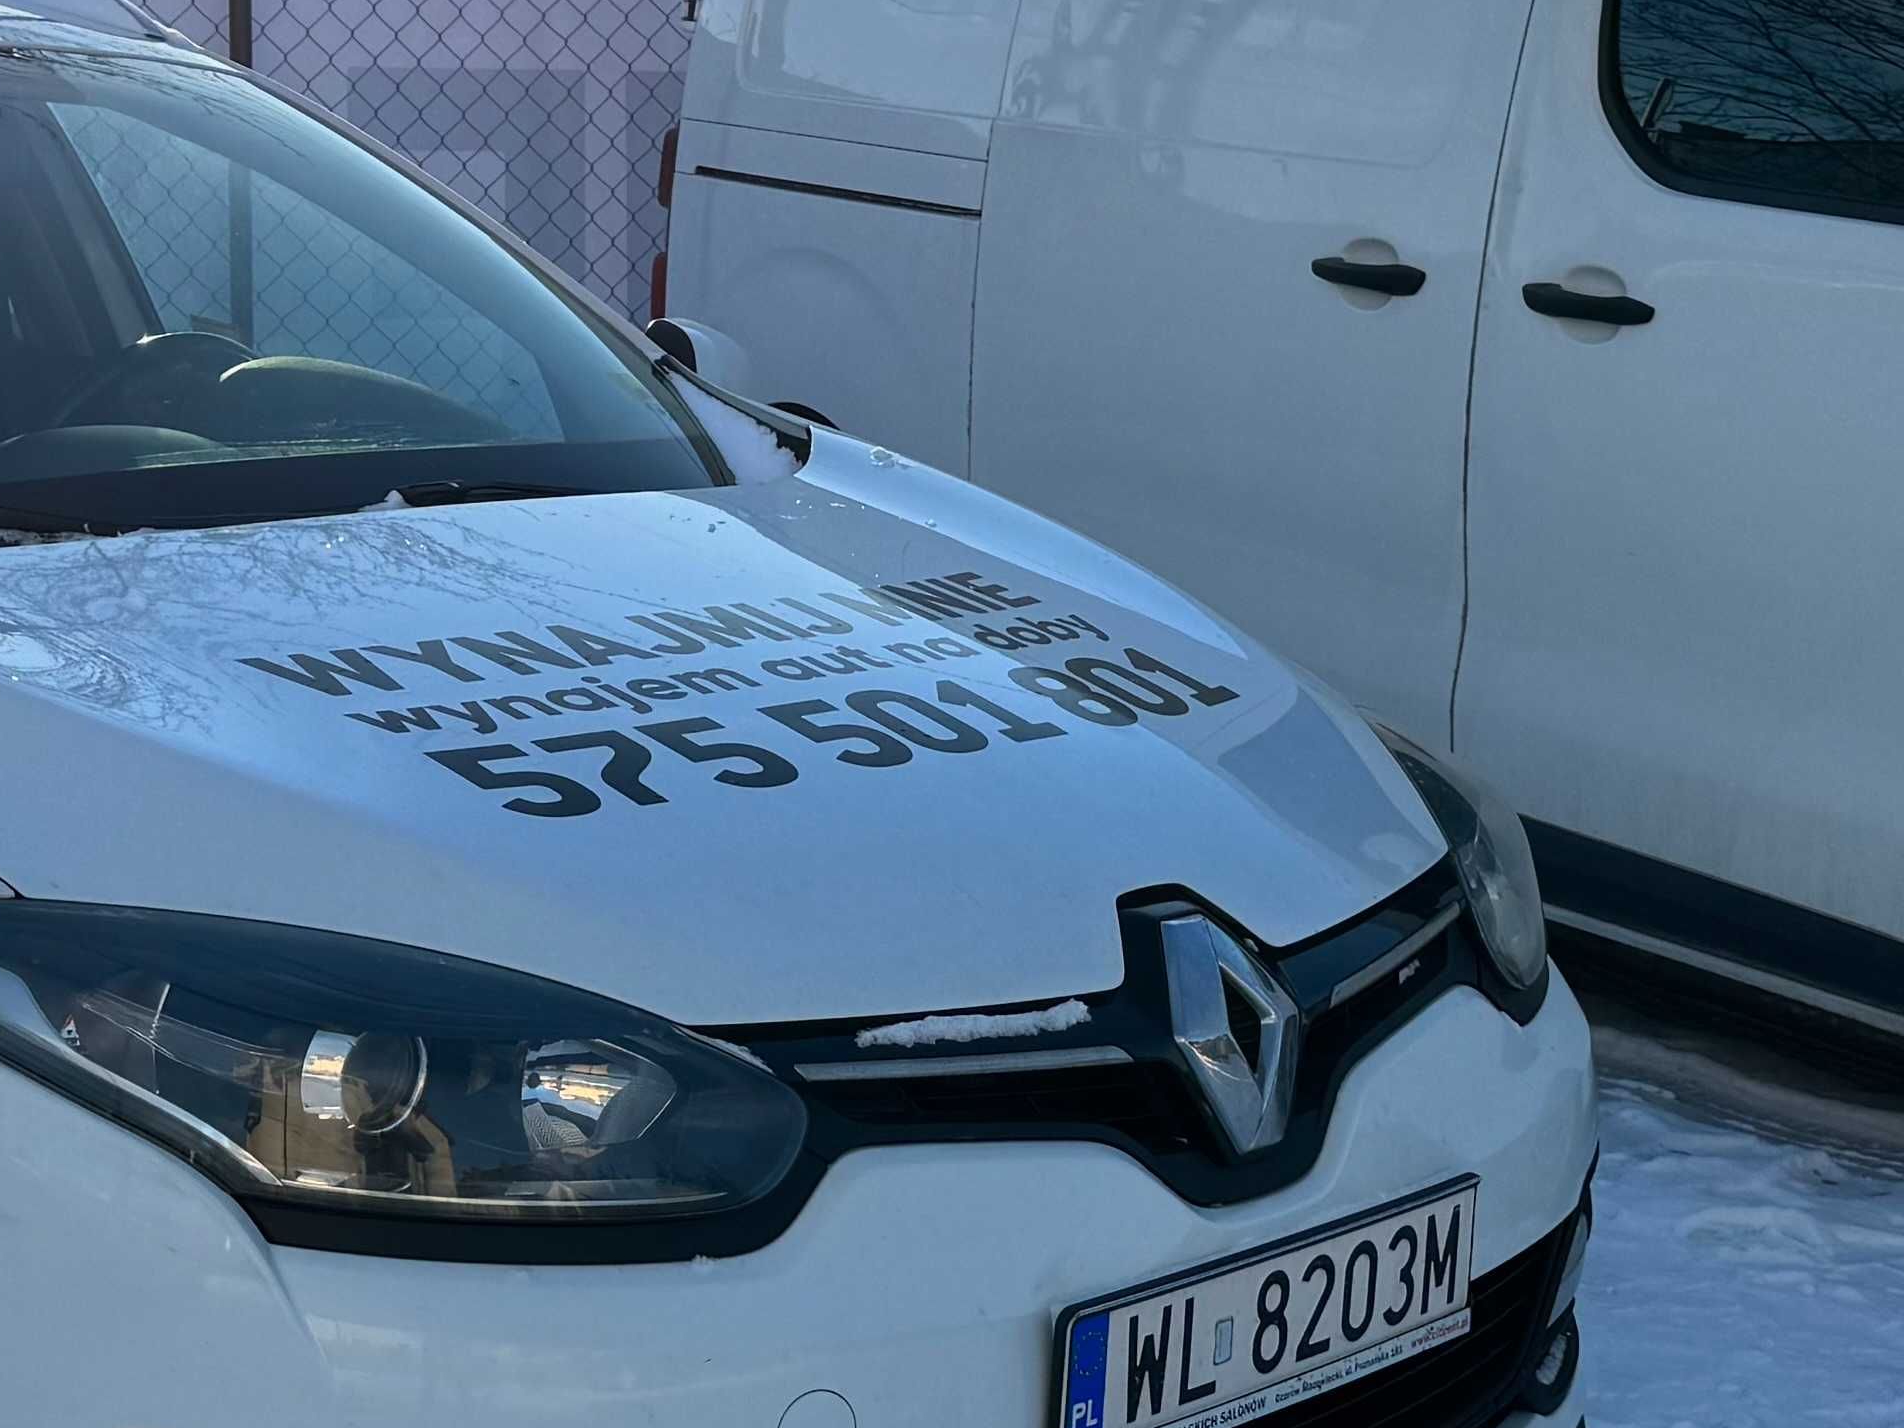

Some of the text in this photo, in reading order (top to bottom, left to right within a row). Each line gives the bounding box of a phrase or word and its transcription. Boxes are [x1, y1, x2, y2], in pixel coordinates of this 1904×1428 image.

[235, 572, 1041, 696] WYNAJMIJ MNIE
[344, 614, 1110, 734] wynajem aut na doby
[422, 647, 1240, 818] 575 501 801
[1126, 1204, 1461, 1425] WL 8203M
